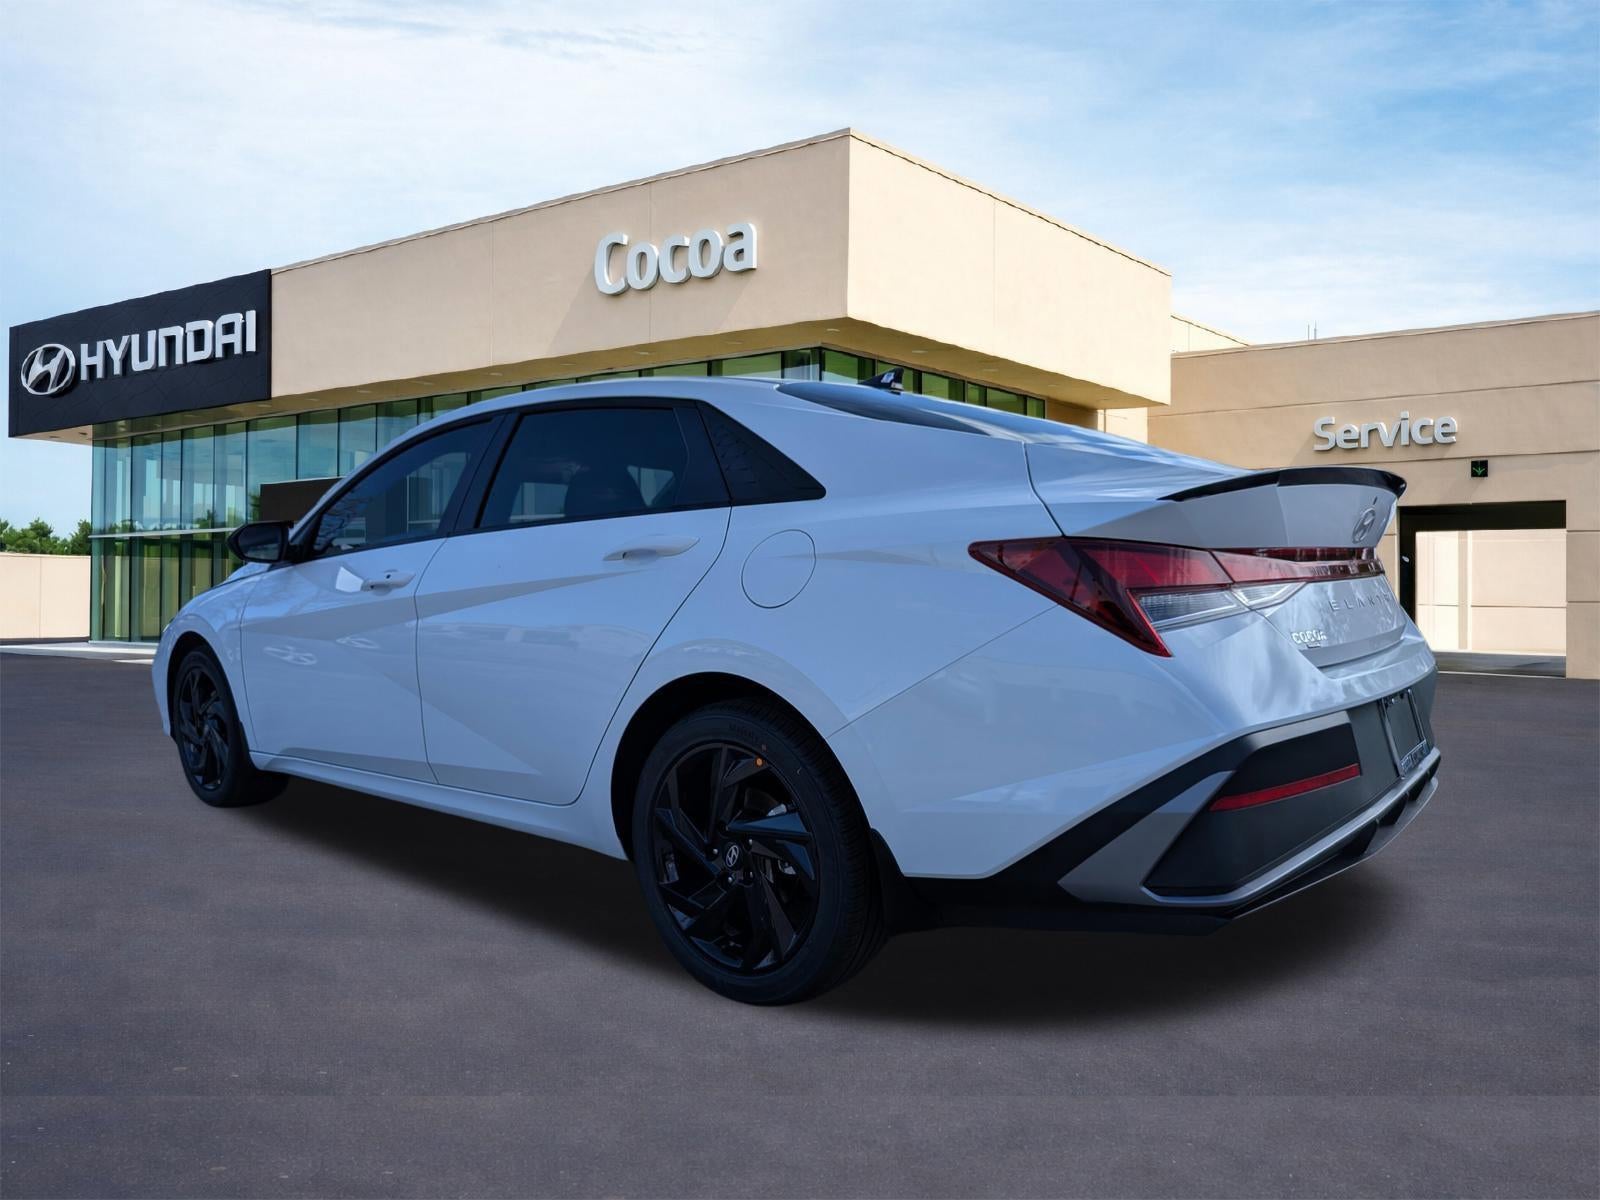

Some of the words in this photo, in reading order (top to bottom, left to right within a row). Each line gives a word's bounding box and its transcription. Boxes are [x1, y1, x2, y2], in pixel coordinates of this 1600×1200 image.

[594, 223, 757, 296] Cocoa
[80, 310, 256, 381] HYUNDAI
[1313, 410, 1458, 451] Service
